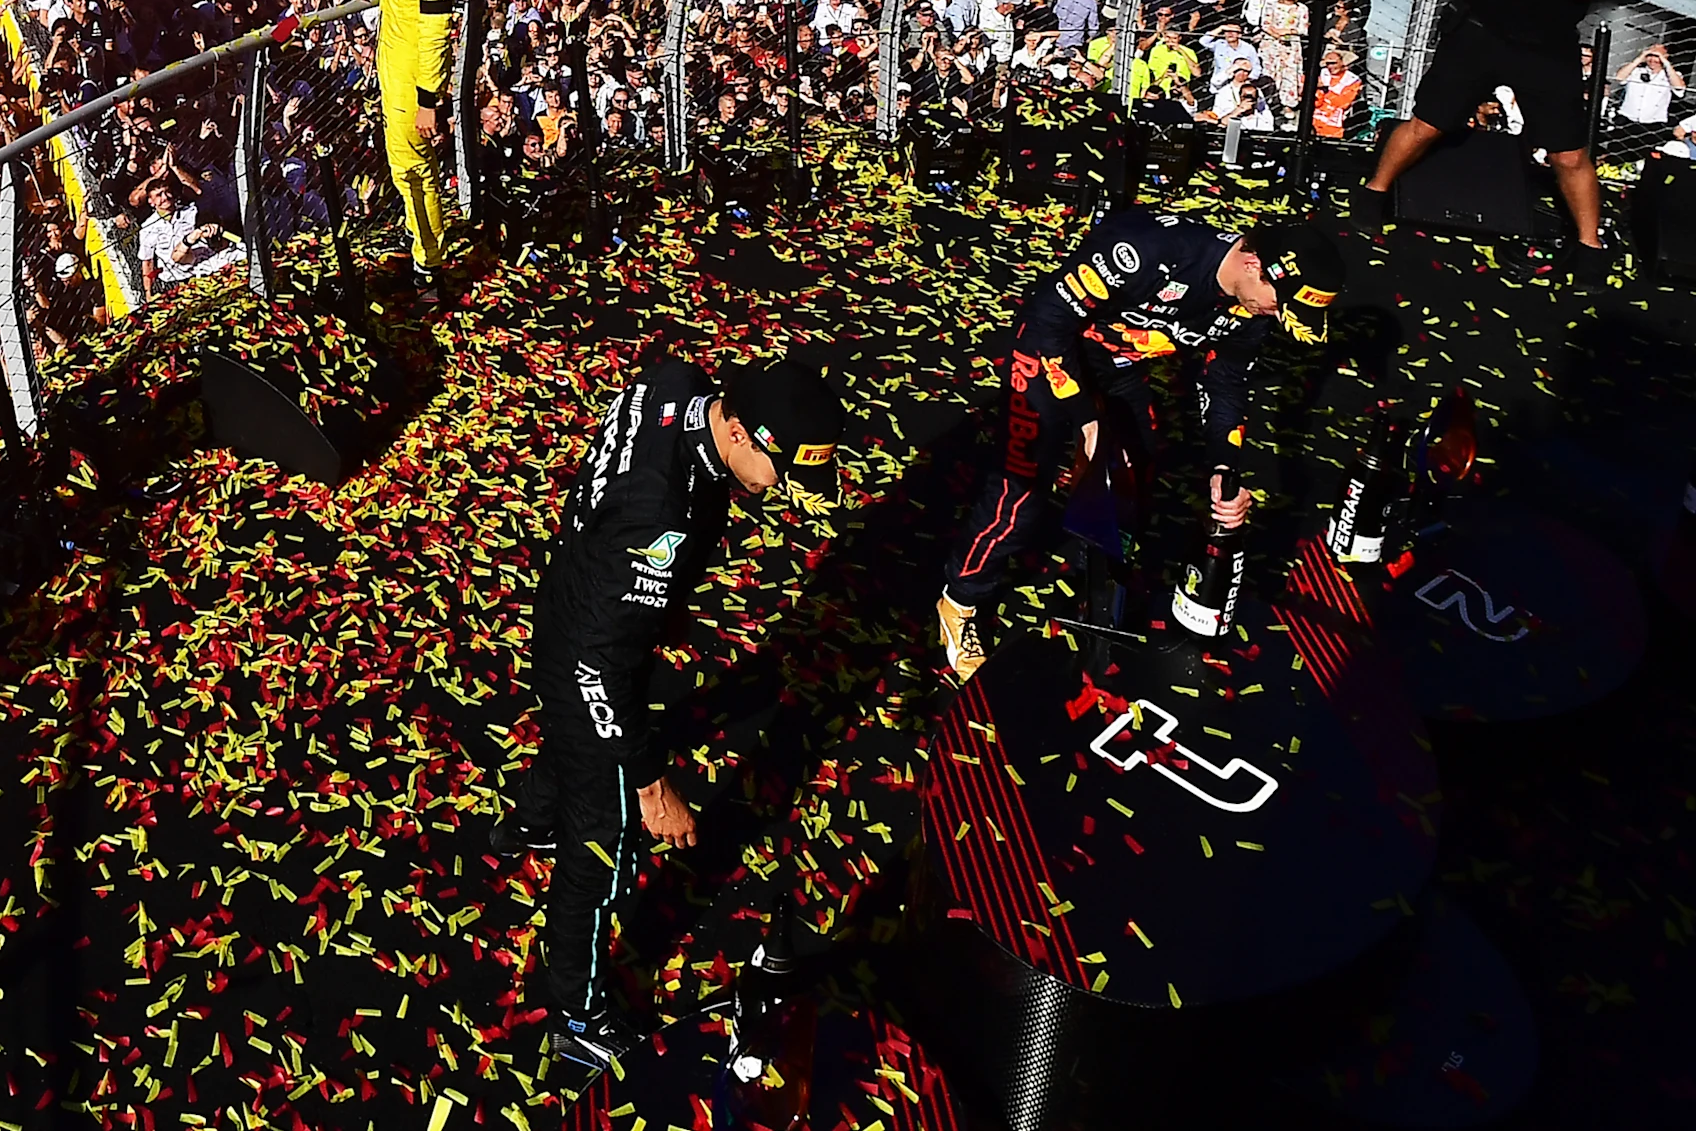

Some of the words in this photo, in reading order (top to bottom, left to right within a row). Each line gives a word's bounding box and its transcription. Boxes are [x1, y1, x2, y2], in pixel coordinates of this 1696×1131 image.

[1091, 252, 1117, 286] Claro
[1117, 246, 1135, 269] Esso
[1055, 281, 1072, 303] Cash
[1070, 301, 1087, 318] App
[1332, 477, 1365, 557] FERRARI
[620, 592, 656, 606] AMD
[633, 575, 668, 595] IWC
[1218, 550, 1244, 636] FERRARI
[574, 659, 623, 739] INEOS
